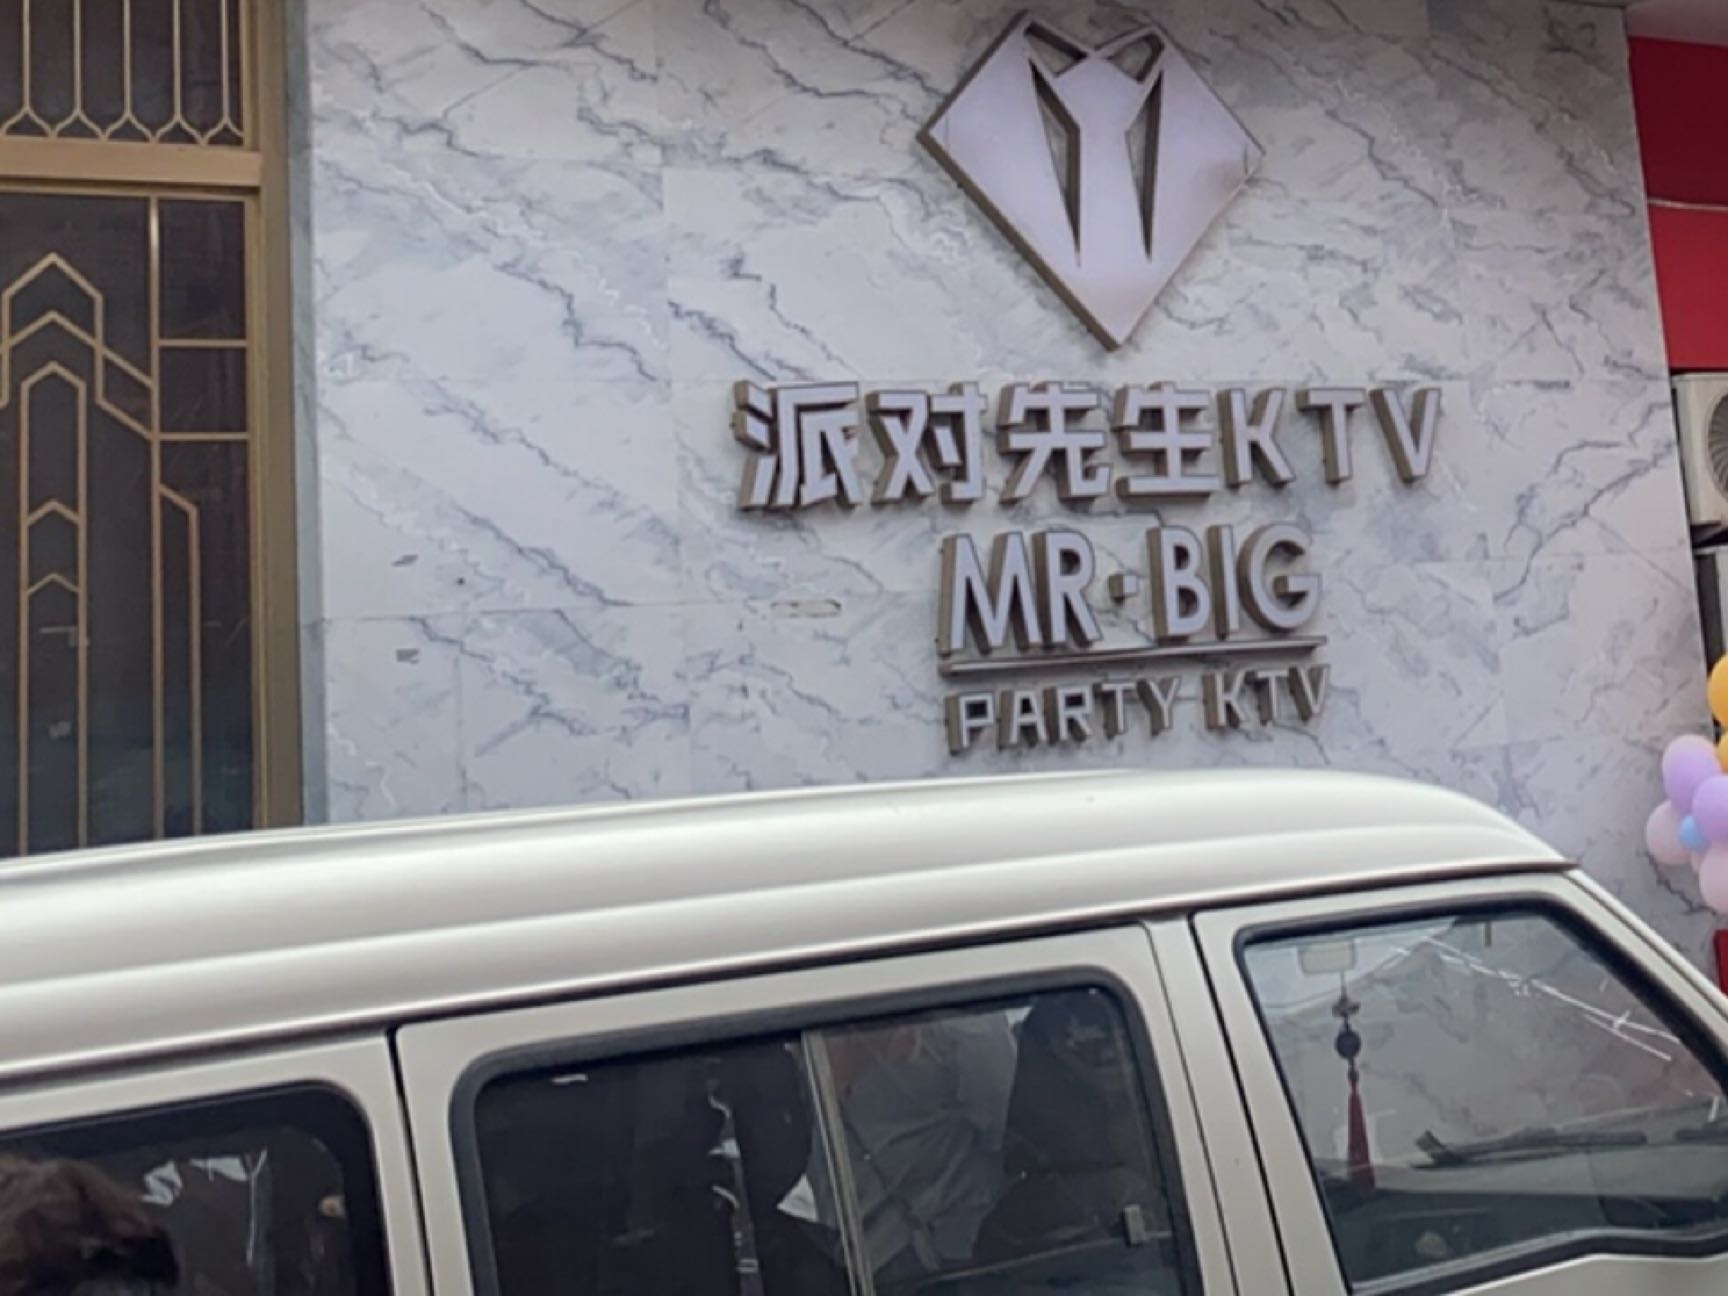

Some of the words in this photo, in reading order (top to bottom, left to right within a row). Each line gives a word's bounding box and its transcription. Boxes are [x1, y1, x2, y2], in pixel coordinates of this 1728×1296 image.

[732, 379, 1442, 510] 派对先生KTV
[946, 676, 1182, 755] PARTY
[1201, 663, 1334, 732] KTV
